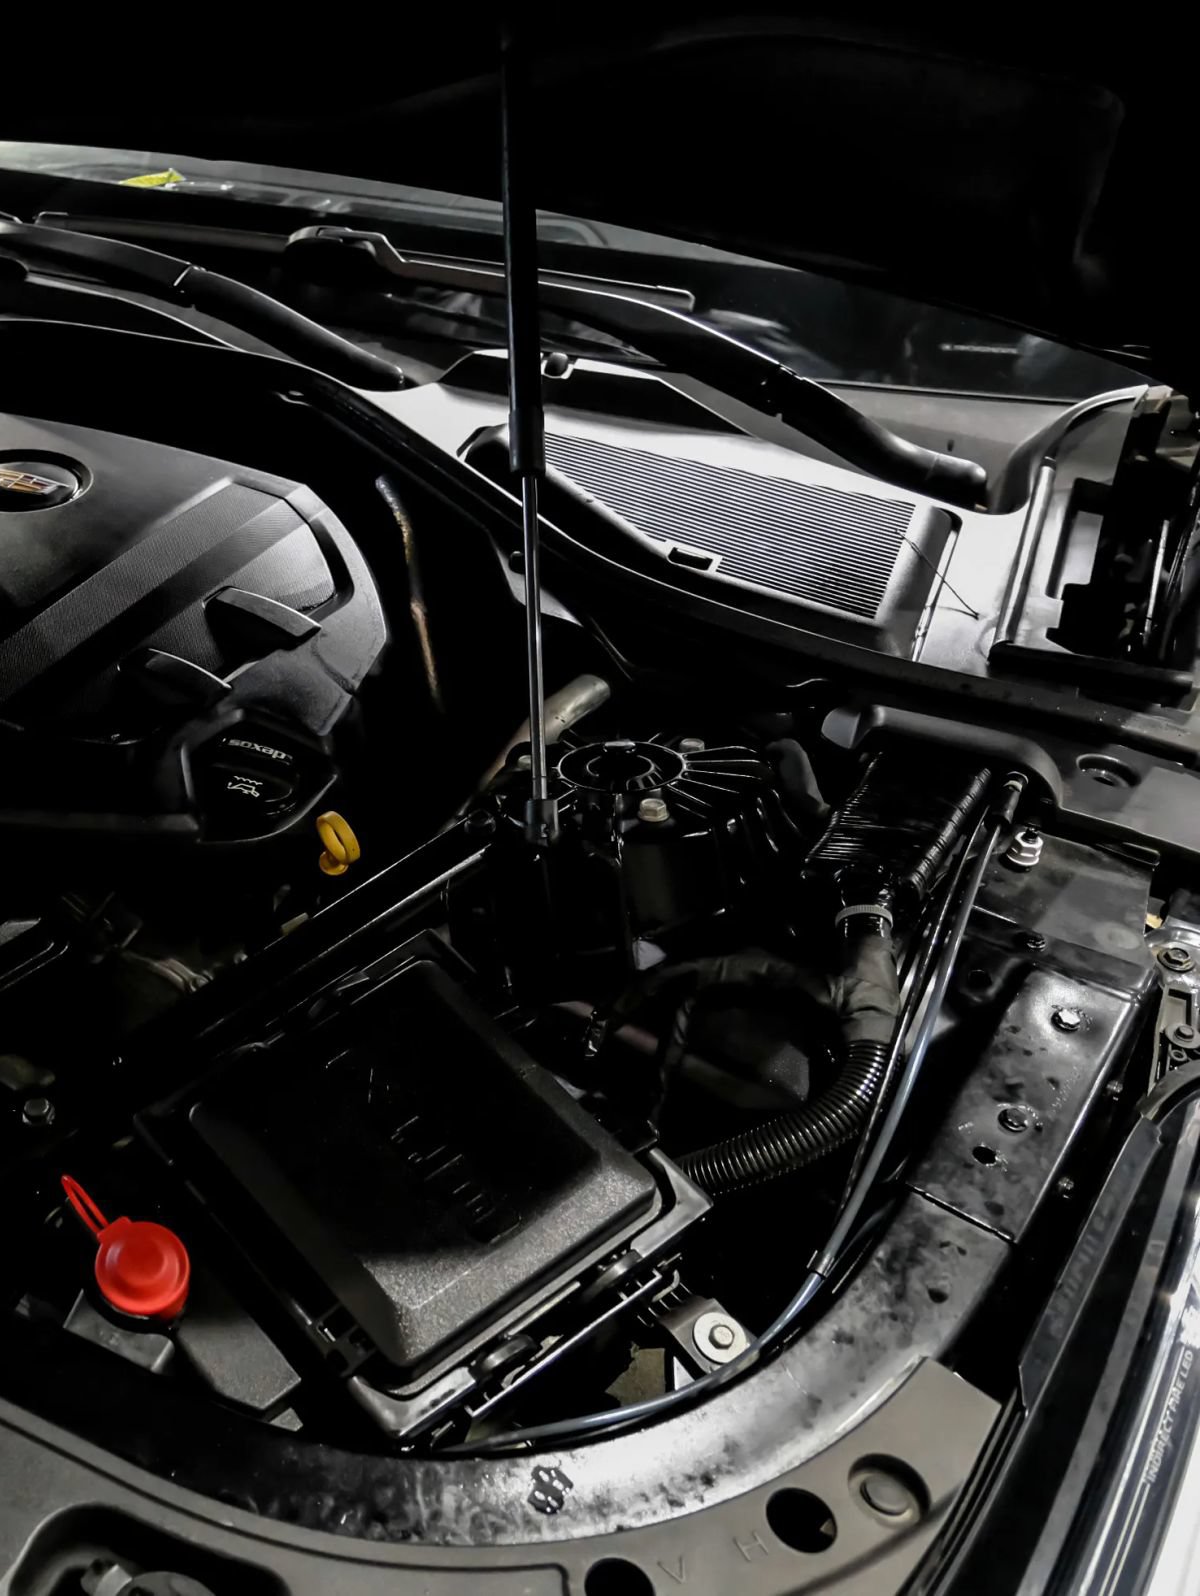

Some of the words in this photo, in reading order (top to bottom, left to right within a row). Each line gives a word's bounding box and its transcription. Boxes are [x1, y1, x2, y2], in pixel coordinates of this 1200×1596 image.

[227, 738, 287, 760] dexos
[1146, 1411, 1175, 1483] INDIRECT
[1180, 1350, 1194, 1379] LED
[657, 1555, 687, 1585] V
[733, 1530, 769, 1561] H
